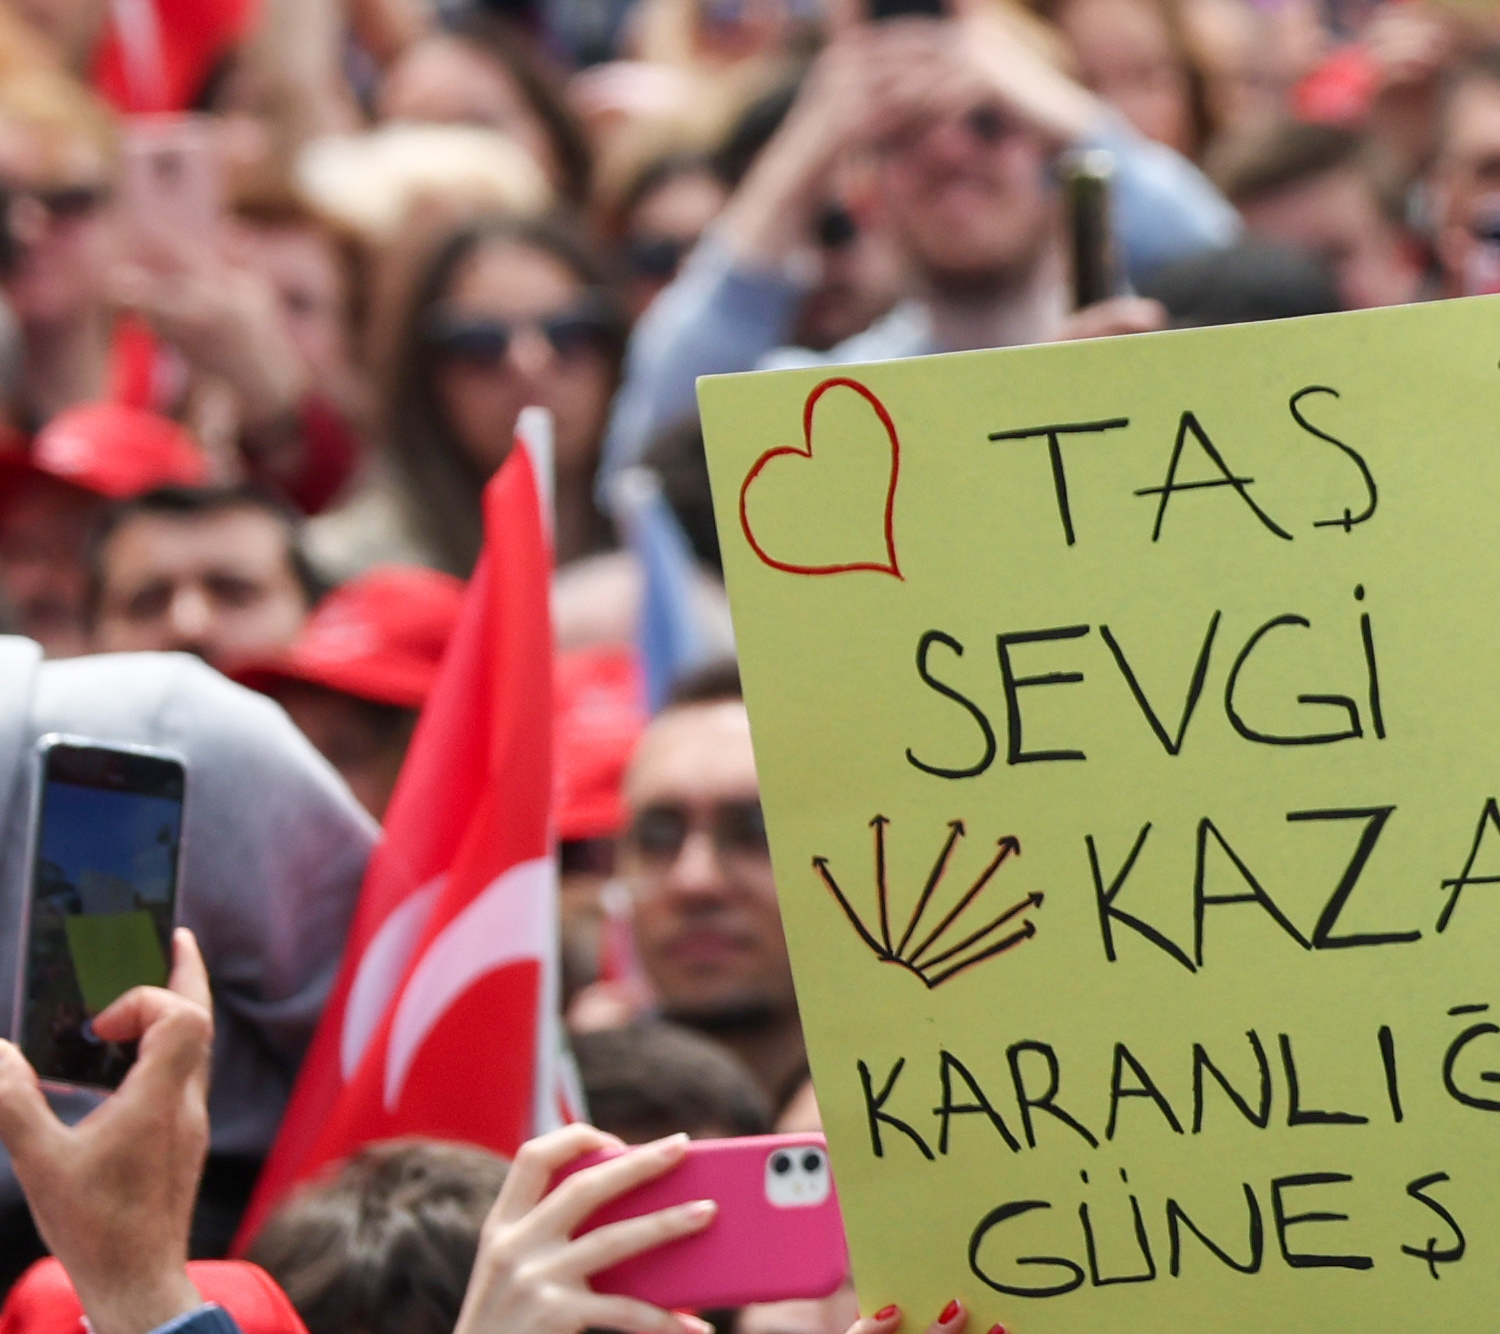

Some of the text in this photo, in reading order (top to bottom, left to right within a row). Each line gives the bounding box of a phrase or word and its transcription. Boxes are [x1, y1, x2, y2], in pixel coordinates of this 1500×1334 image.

[988, 384, 1377, 547] TAŞ
[905, 583, 1388, 780] SEVGİ
[968, 1171, 1466, 1299] GÜNEŞ
